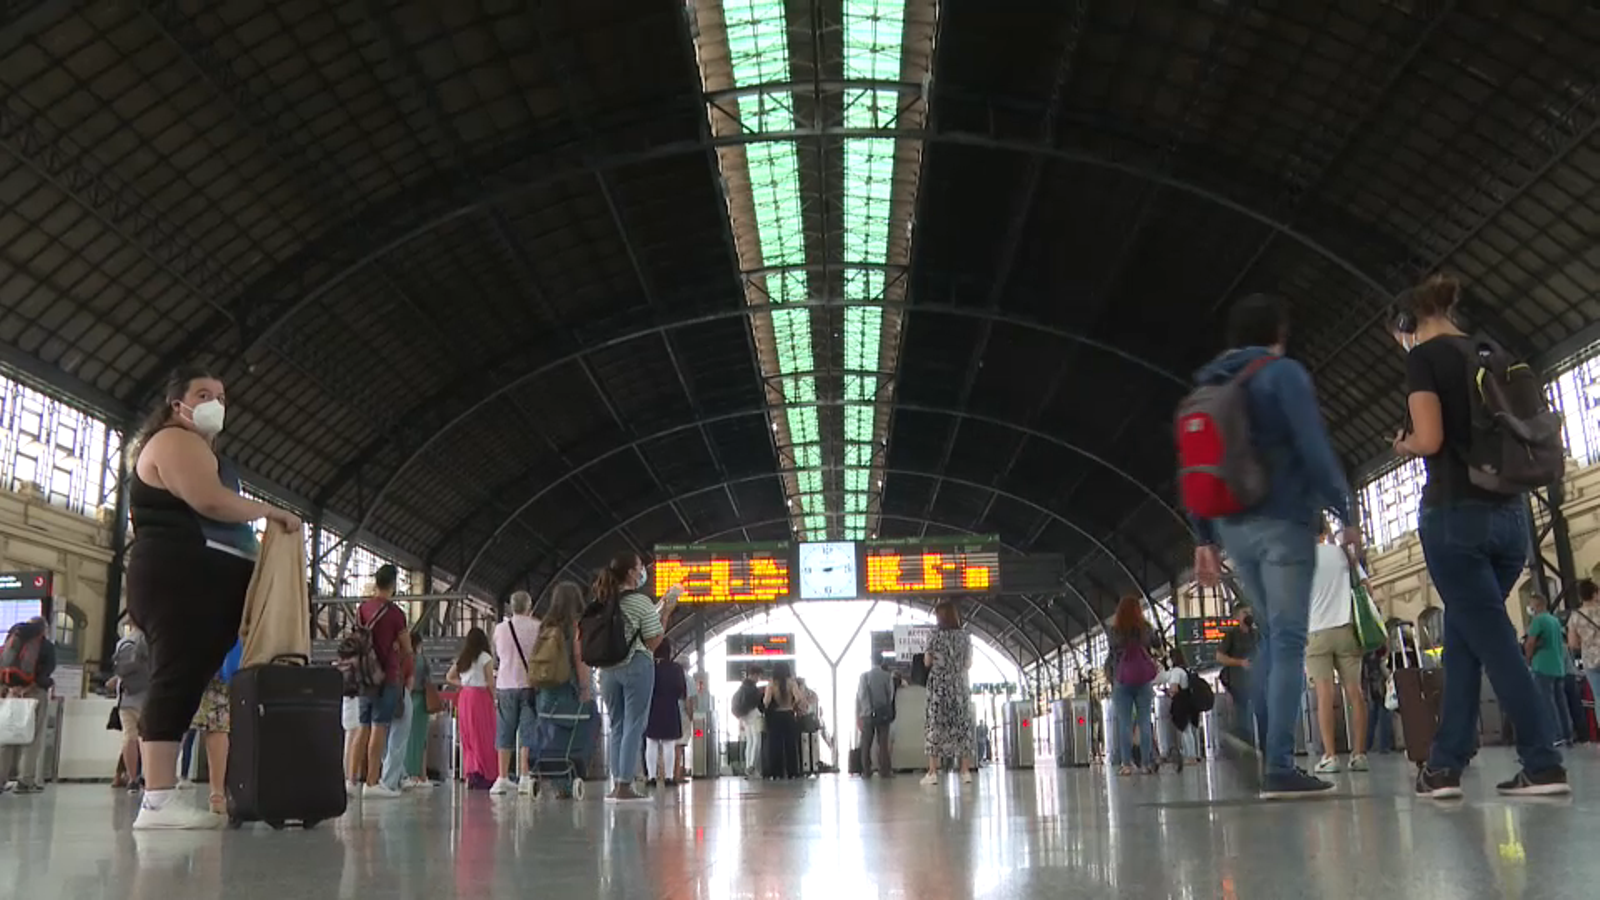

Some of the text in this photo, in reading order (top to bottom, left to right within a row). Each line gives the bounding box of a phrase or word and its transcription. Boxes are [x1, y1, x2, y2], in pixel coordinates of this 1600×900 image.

[1193, 629, 1199, 639] 5
[741, 645, 747, 654] 3
[1195, 654, 1202, 665] 5
